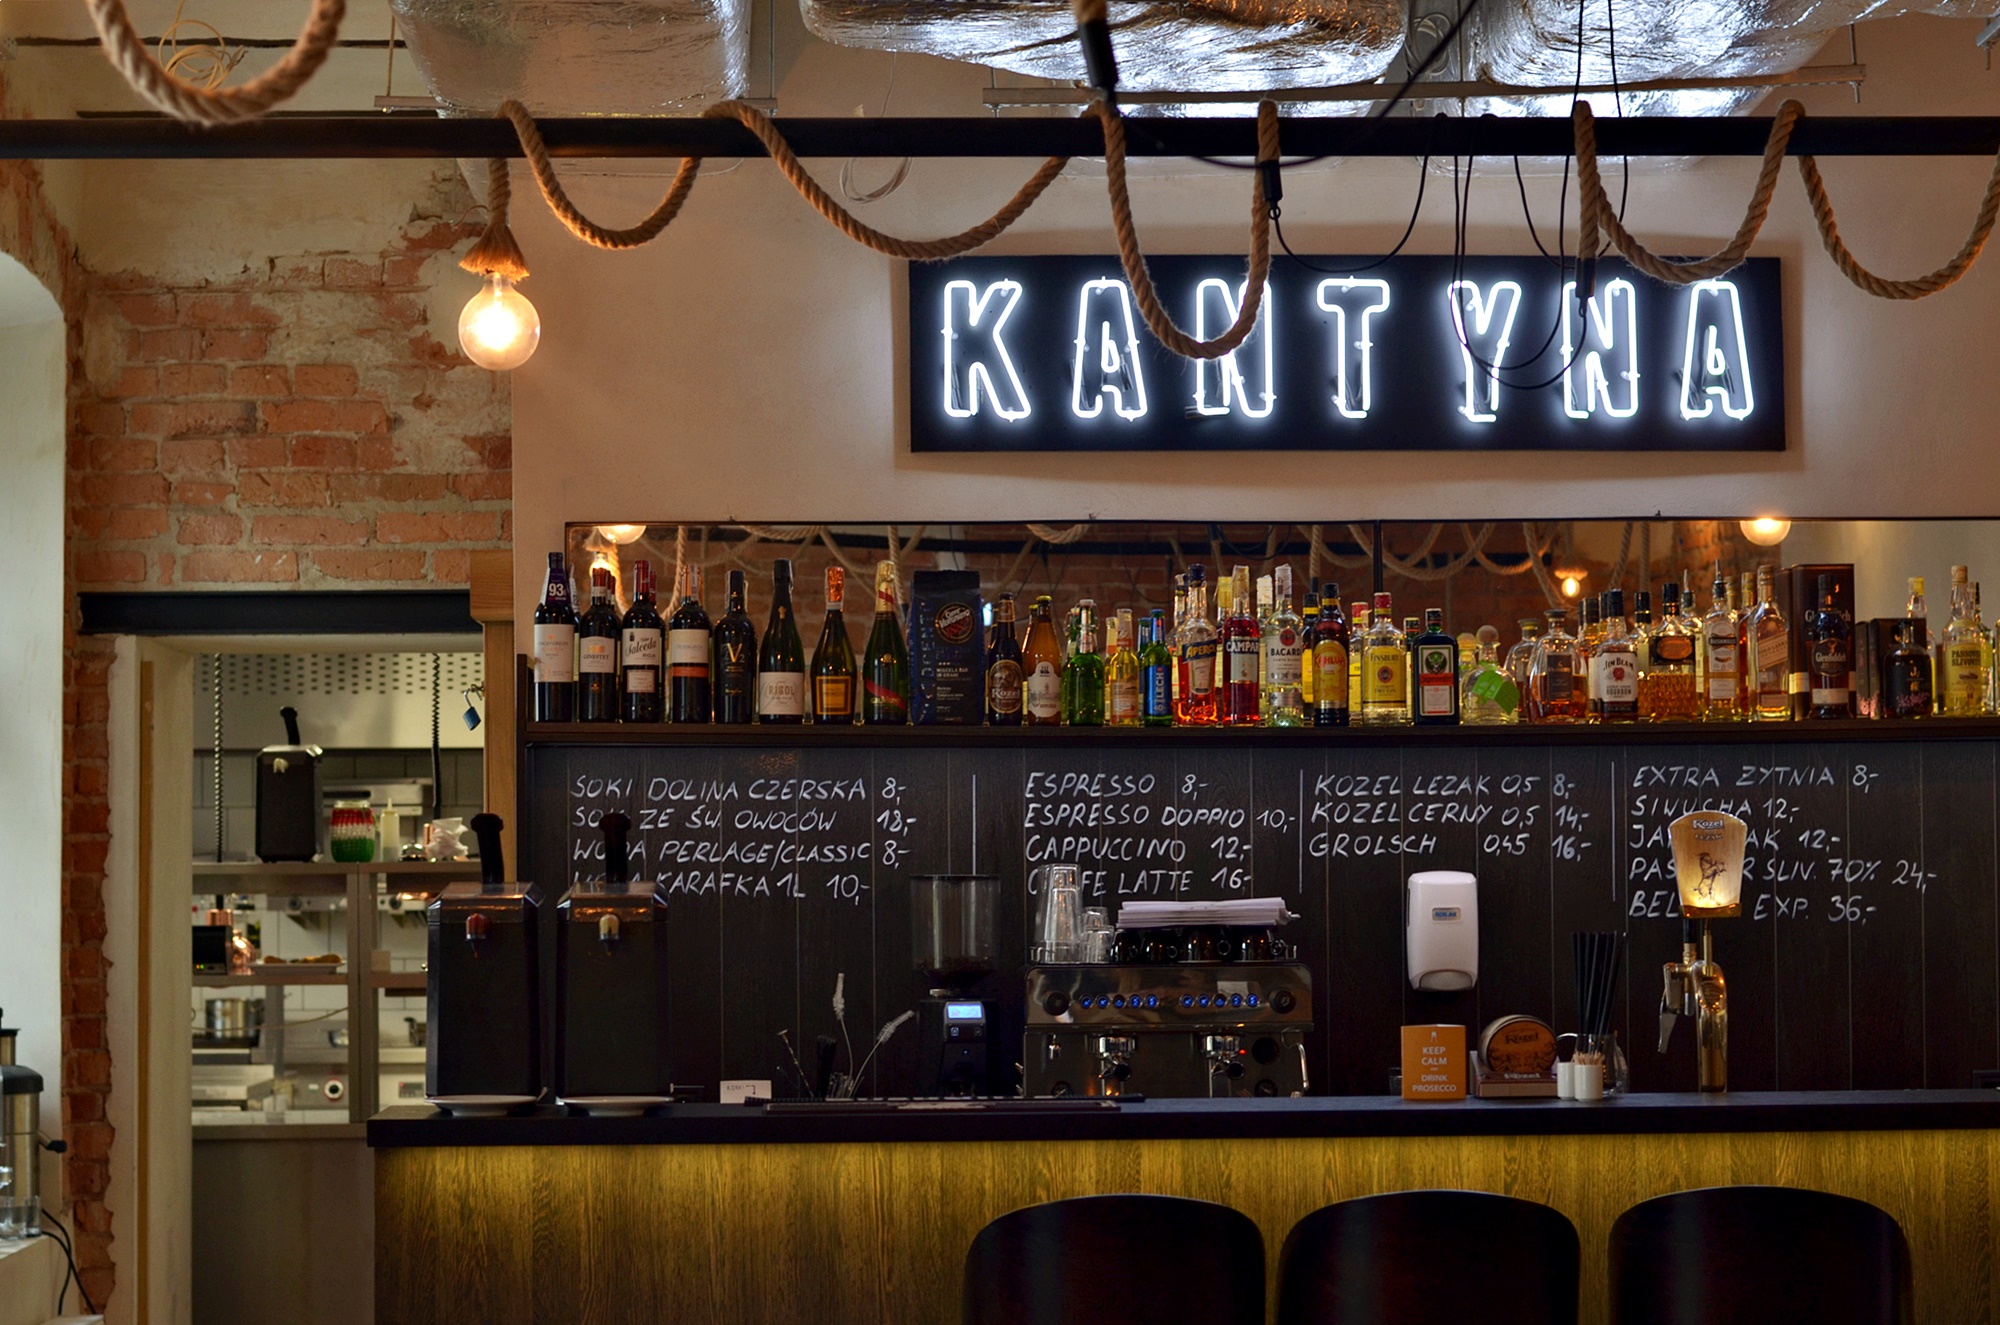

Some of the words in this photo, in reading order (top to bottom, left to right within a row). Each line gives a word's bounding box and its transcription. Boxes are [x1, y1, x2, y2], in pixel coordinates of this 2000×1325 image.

[943, 277, 1757, 424] KANTYNA
[1185, 644, 1216, 660] APERO
[1226, 641, 1260, 652] CAMPAR
[1270, 648, 1301, 656] BACARD
[1025, 772, 1156, 798] ESPRESSO
[1314, 774, 1401, 797] KOZEL
[1412, 775, 1491, 797] LEZAK
[1632, 765, 1720, 788] EXTRA
[571, 775, 633, 799] SOKI
[648, 778, 739, 803] DOLINA
[748, 778, 867, 802] CZERSKA
[639, 808, 676, 830] ZE
[734, 807, 838, 834] OWOCÓW
[1024, 802, 1150, 828] ESPRESSO
[1161, 806, 1245, 828] DOPPIO
[1311, 801, 1401, 824] KOZEL
[1408, 802, 1493, 825] CERNY
[1693, 819, 1723, 829] Kozel
[1026, 834, 1186, 863] CAPPUCCINO
[1309, 832, 1437, 858] GROLSCH
[1828, 857, 1882, 883] 70%
[1117, 869, 1194, 895] LATTE
[1421, 1057, 1448, 1066] CALM
[1422, 1046, 1446, 1055] KEEP
[1412, 1084, 1456, 1092] PROSECCO
[1421, 1074, 1448, 1082] DRINK
